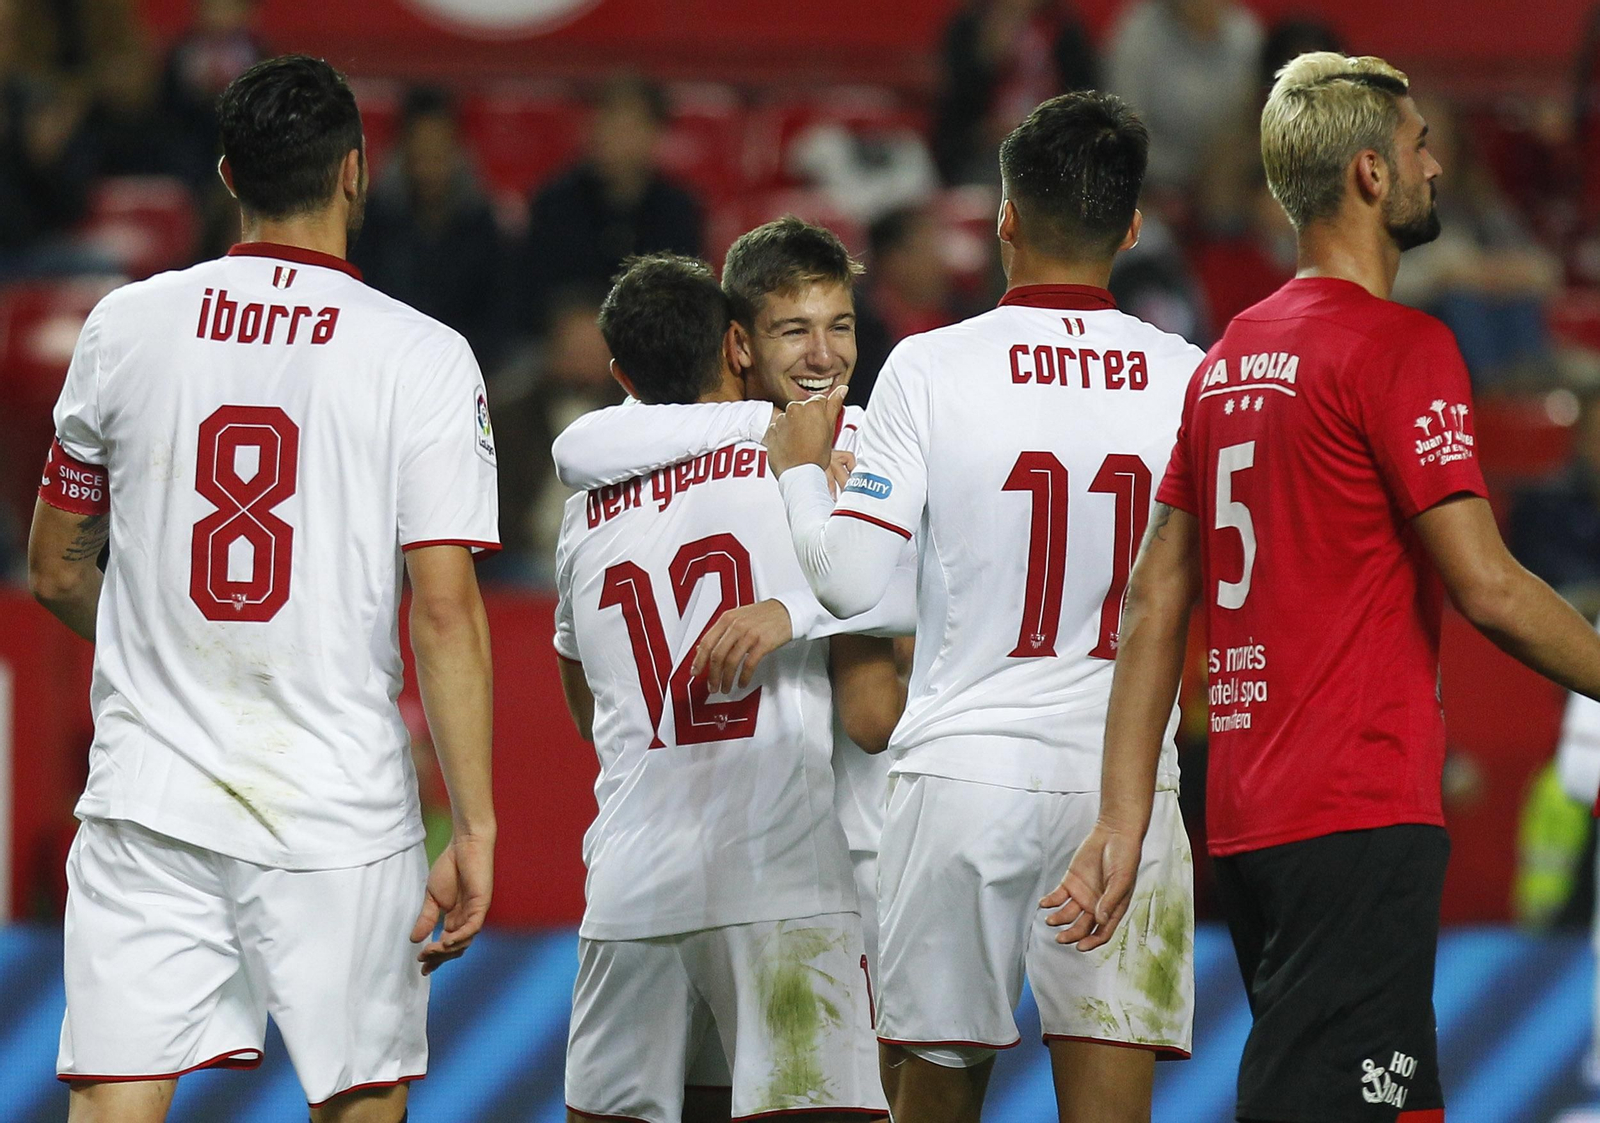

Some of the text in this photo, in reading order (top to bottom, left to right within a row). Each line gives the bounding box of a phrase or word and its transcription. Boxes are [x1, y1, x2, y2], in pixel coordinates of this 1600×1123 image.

[196, 287, 341, 345] iborra
[1008, 344, 1149, 391] correa
[1240, 352, 1300, 384] VOLTA
[1415, 435, 1443, 455] Juan
[1443, 430, 1453, 445] y
[59, 465, 103, 486] SINCE
[61, 480, 103, 502] 1890
[189, 404, 300, 623] 8
[1215, 440, 1257, 610] 5
[1000, 451, 1153, 661] 11
[598, 532, 763, 750] 12
[1240, 681, 1268, 708] spa
